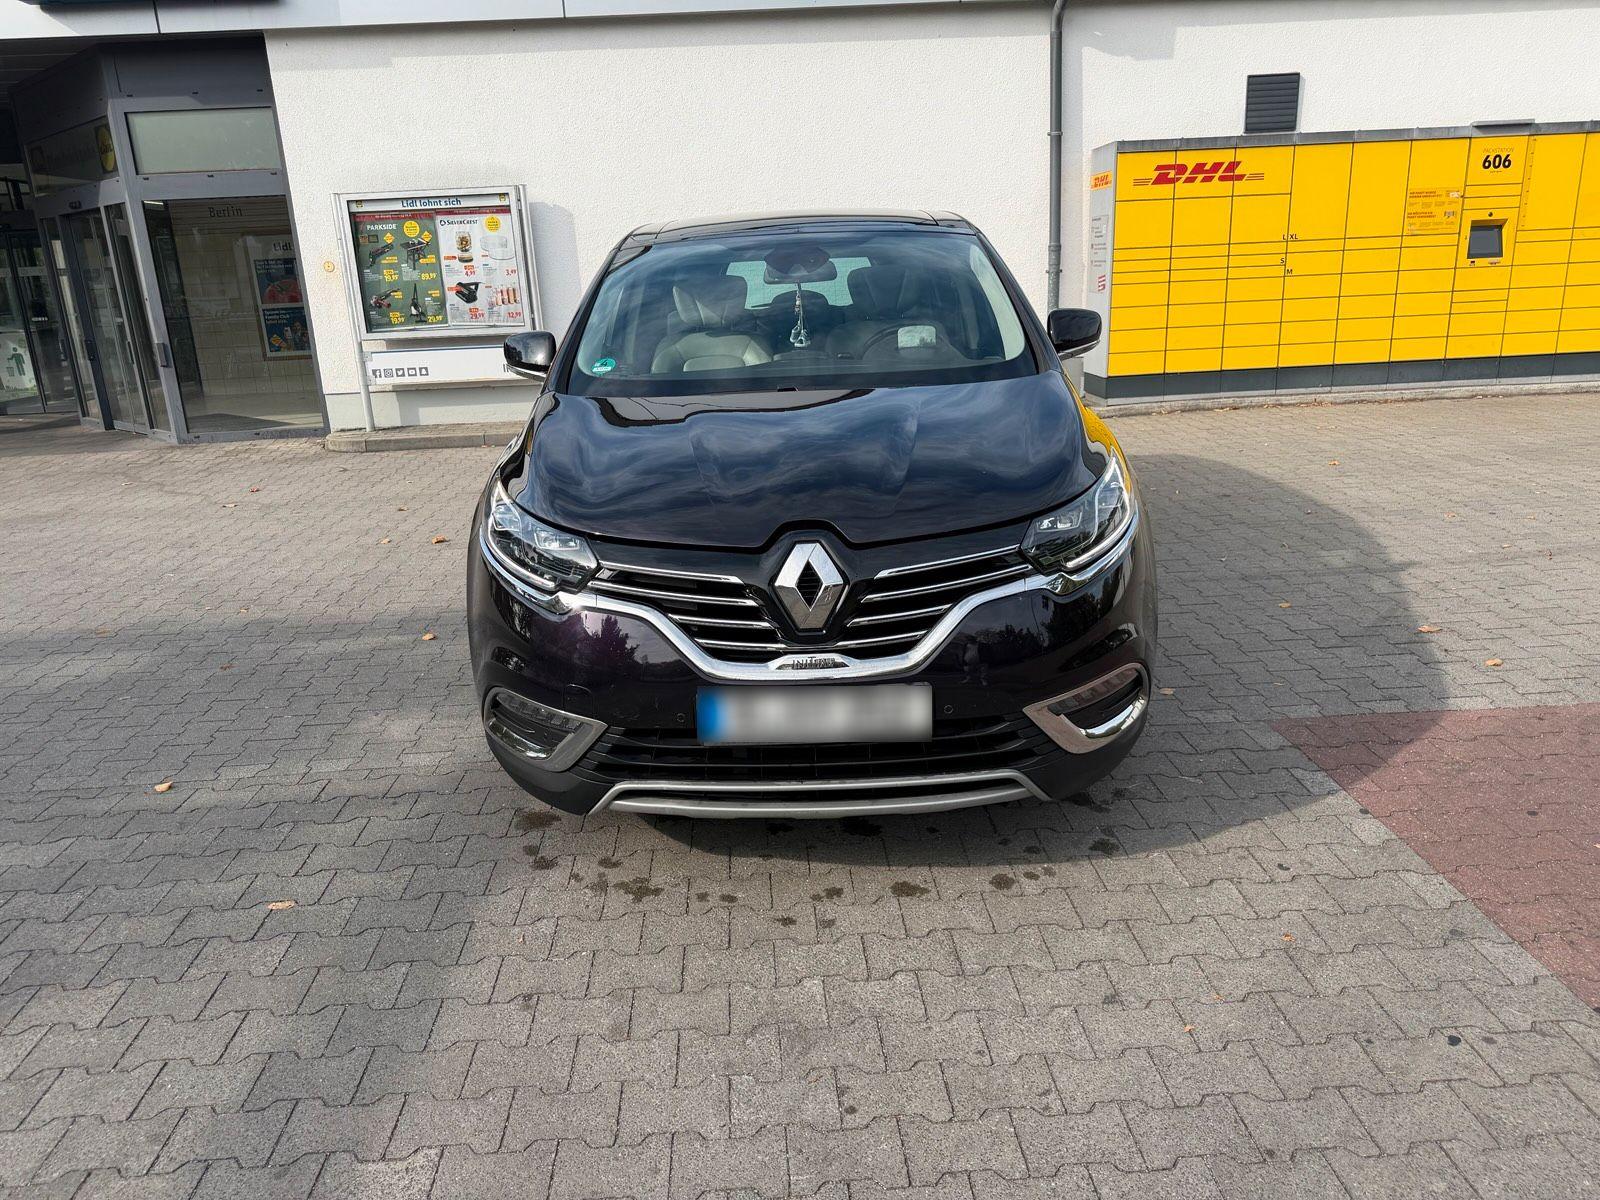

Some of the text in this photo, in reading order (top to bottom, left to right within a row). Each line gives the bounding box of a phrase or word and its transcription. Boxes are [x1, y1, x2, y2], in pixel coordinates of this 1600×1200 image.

[1482, 154, 1512, 169] 606
[1151, 161, 1247, 185] DHL
[401, 197, 462, 208] Lidl lohnt sich
[208, 206, 243, 217] Berlin
[366, 223, 397, 231] PARKSIDE
[273, 241, 293, 252] Lidl
